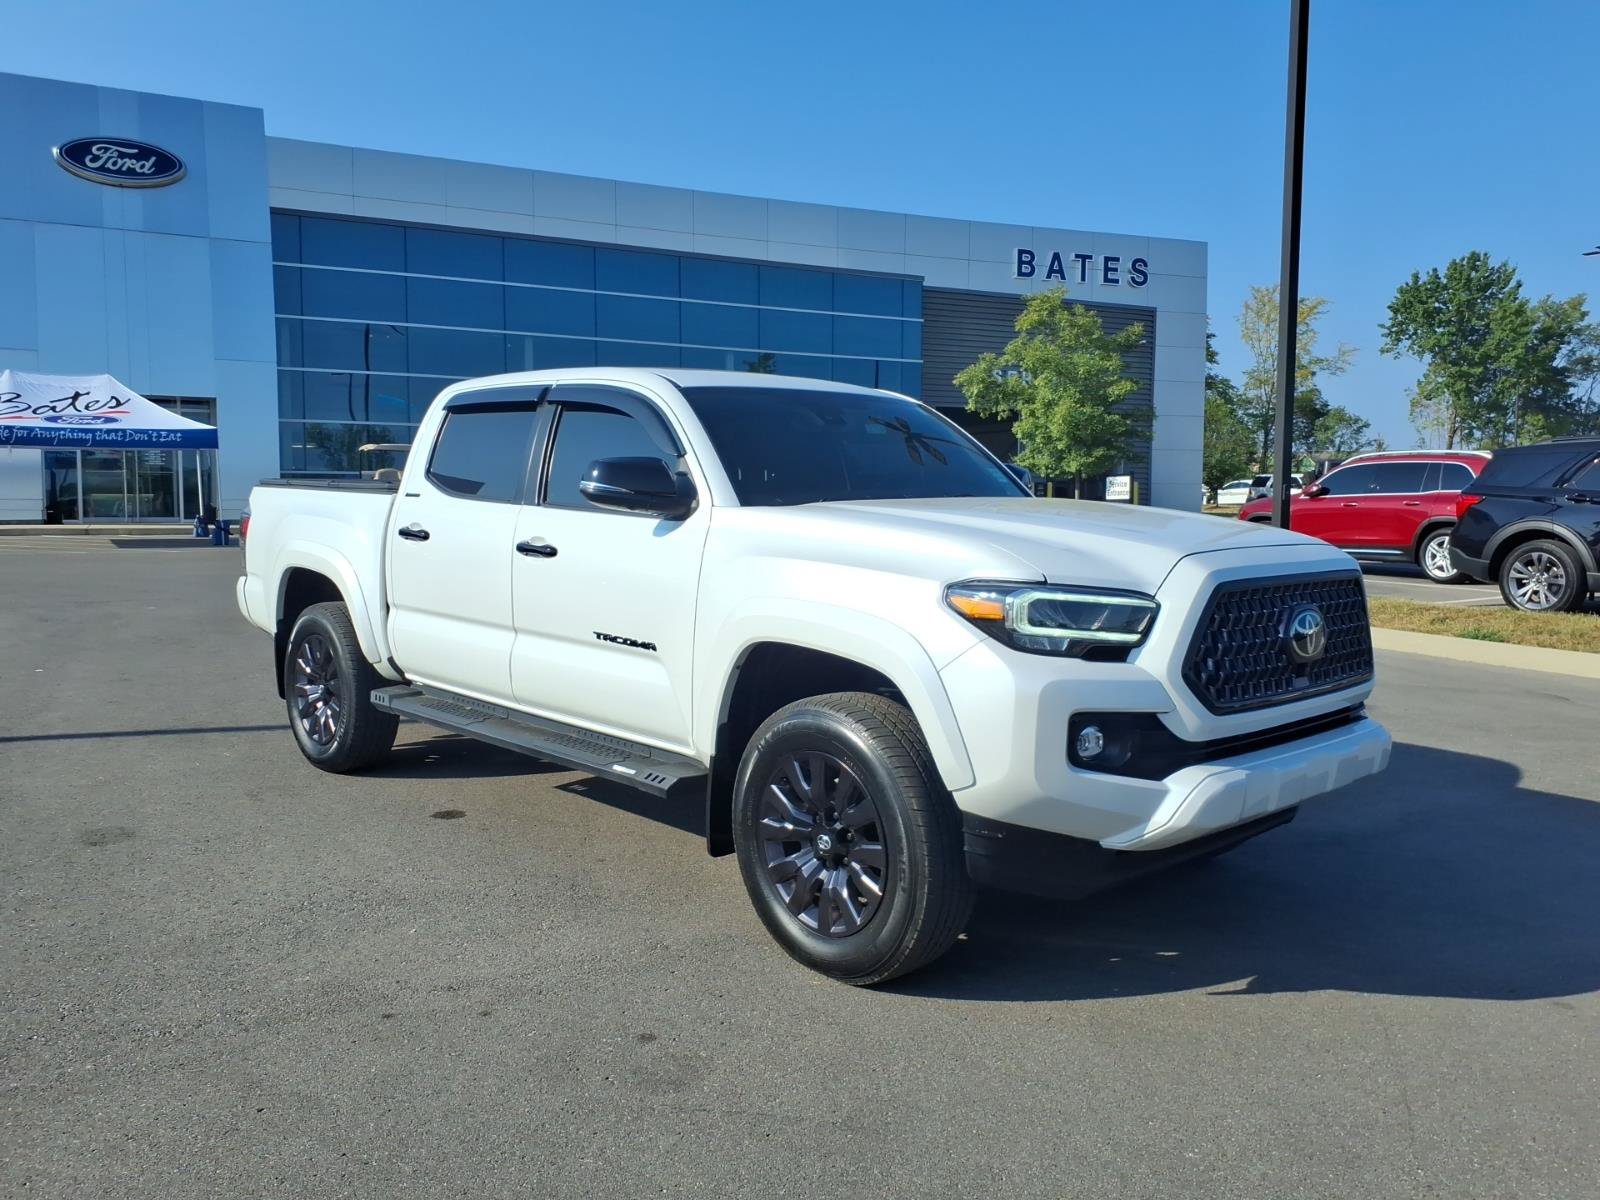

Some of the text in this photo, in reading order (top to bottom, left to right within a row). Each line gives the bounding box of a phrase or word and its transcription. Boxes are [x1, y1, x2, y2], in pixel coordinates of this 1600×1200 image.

[84, 143, 157, 174] Ford
[1015, 248, 1149, 287] BATES
[0, 391, 132, 415] Bates
[57, 416, 106, 424] Ford
[9, 425, 29, 443] for
[31, 428, 93, 446] Anything
[95, 428, 123, 441] that
[125, 430, 158, 442] Don't
[159, 431, 183, 441] Eat
[592, 631, 657, 652] TACOMA
